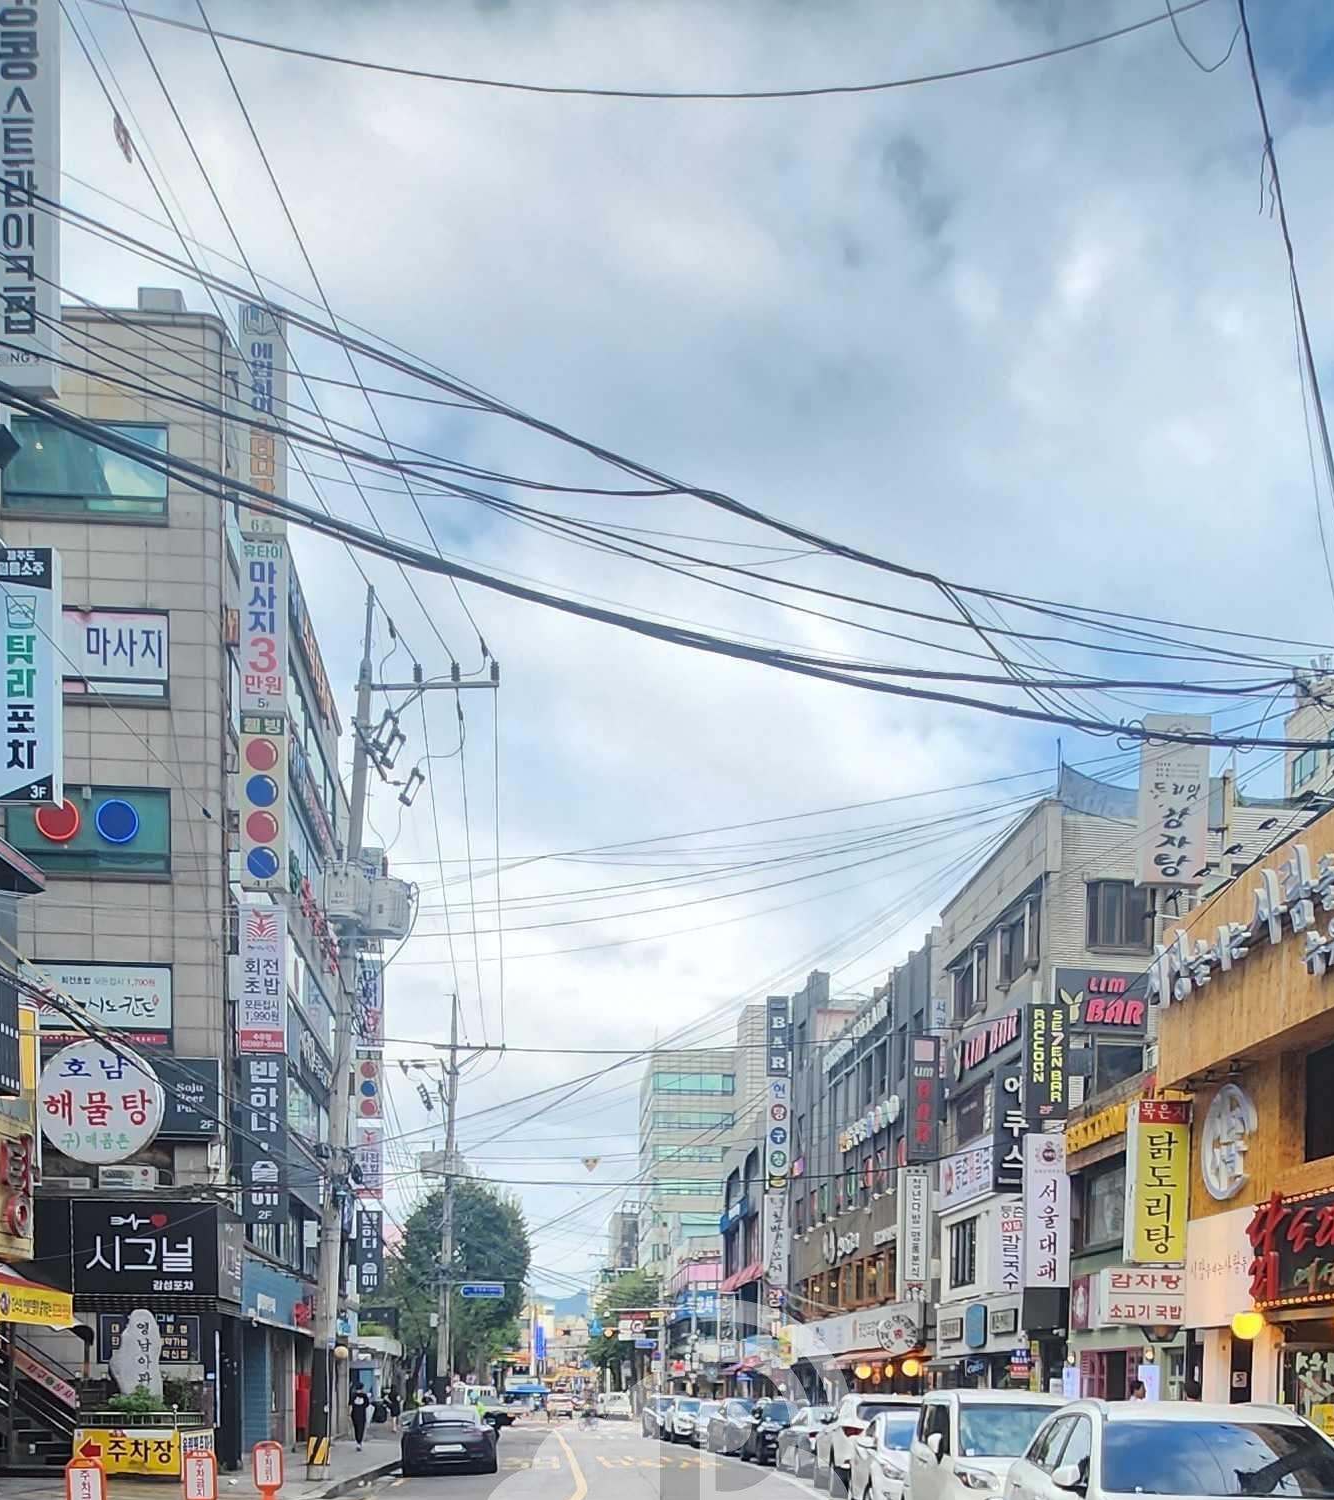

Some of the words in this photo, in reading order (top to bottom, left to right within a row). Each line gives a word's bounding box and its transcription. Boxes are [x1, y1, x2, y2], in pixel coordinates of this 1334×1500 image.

[247, 561, 278, 634] 마사지
[86, 625, 164, 669] 마사지
[248, 637, 278, 673] 3
[244, 675, 283, 698] 만원
[30, 785, 48, 800] 3F
[244, 957, 280, 976] 회전
[244, 977, 280, 996] 초밥
[1085, 997, 1147, 1026] BAR
[1033, 1008, 1046, 1084] RACCOON
[59, 1054, 130, 1081] 호남
[175, 1082, 204, 1093] Soju
[1051, 1070, 1064, 1104] BAR
[43, 1088, 153, 1127] 해물탕
[200, 1119, 216, 1130] 2F
[1145, 1129, 1179, 1255] 닭도리탕
[258, 1209, 273, 1220] 2F
[1036, 1178, 1059, 1284] 서울대패
[1002, 1233, 1022, 1291] 칼국수
[1110, 1272, 1183, 1291] 감자탕
[1109, 1303, 1151, 1321] 소고기
[1154, 1303, 1183, 1321] 국밥
[136, 1321, 154, 1387] 영남아파
[107, 1439, 175, 1465] 주차장
